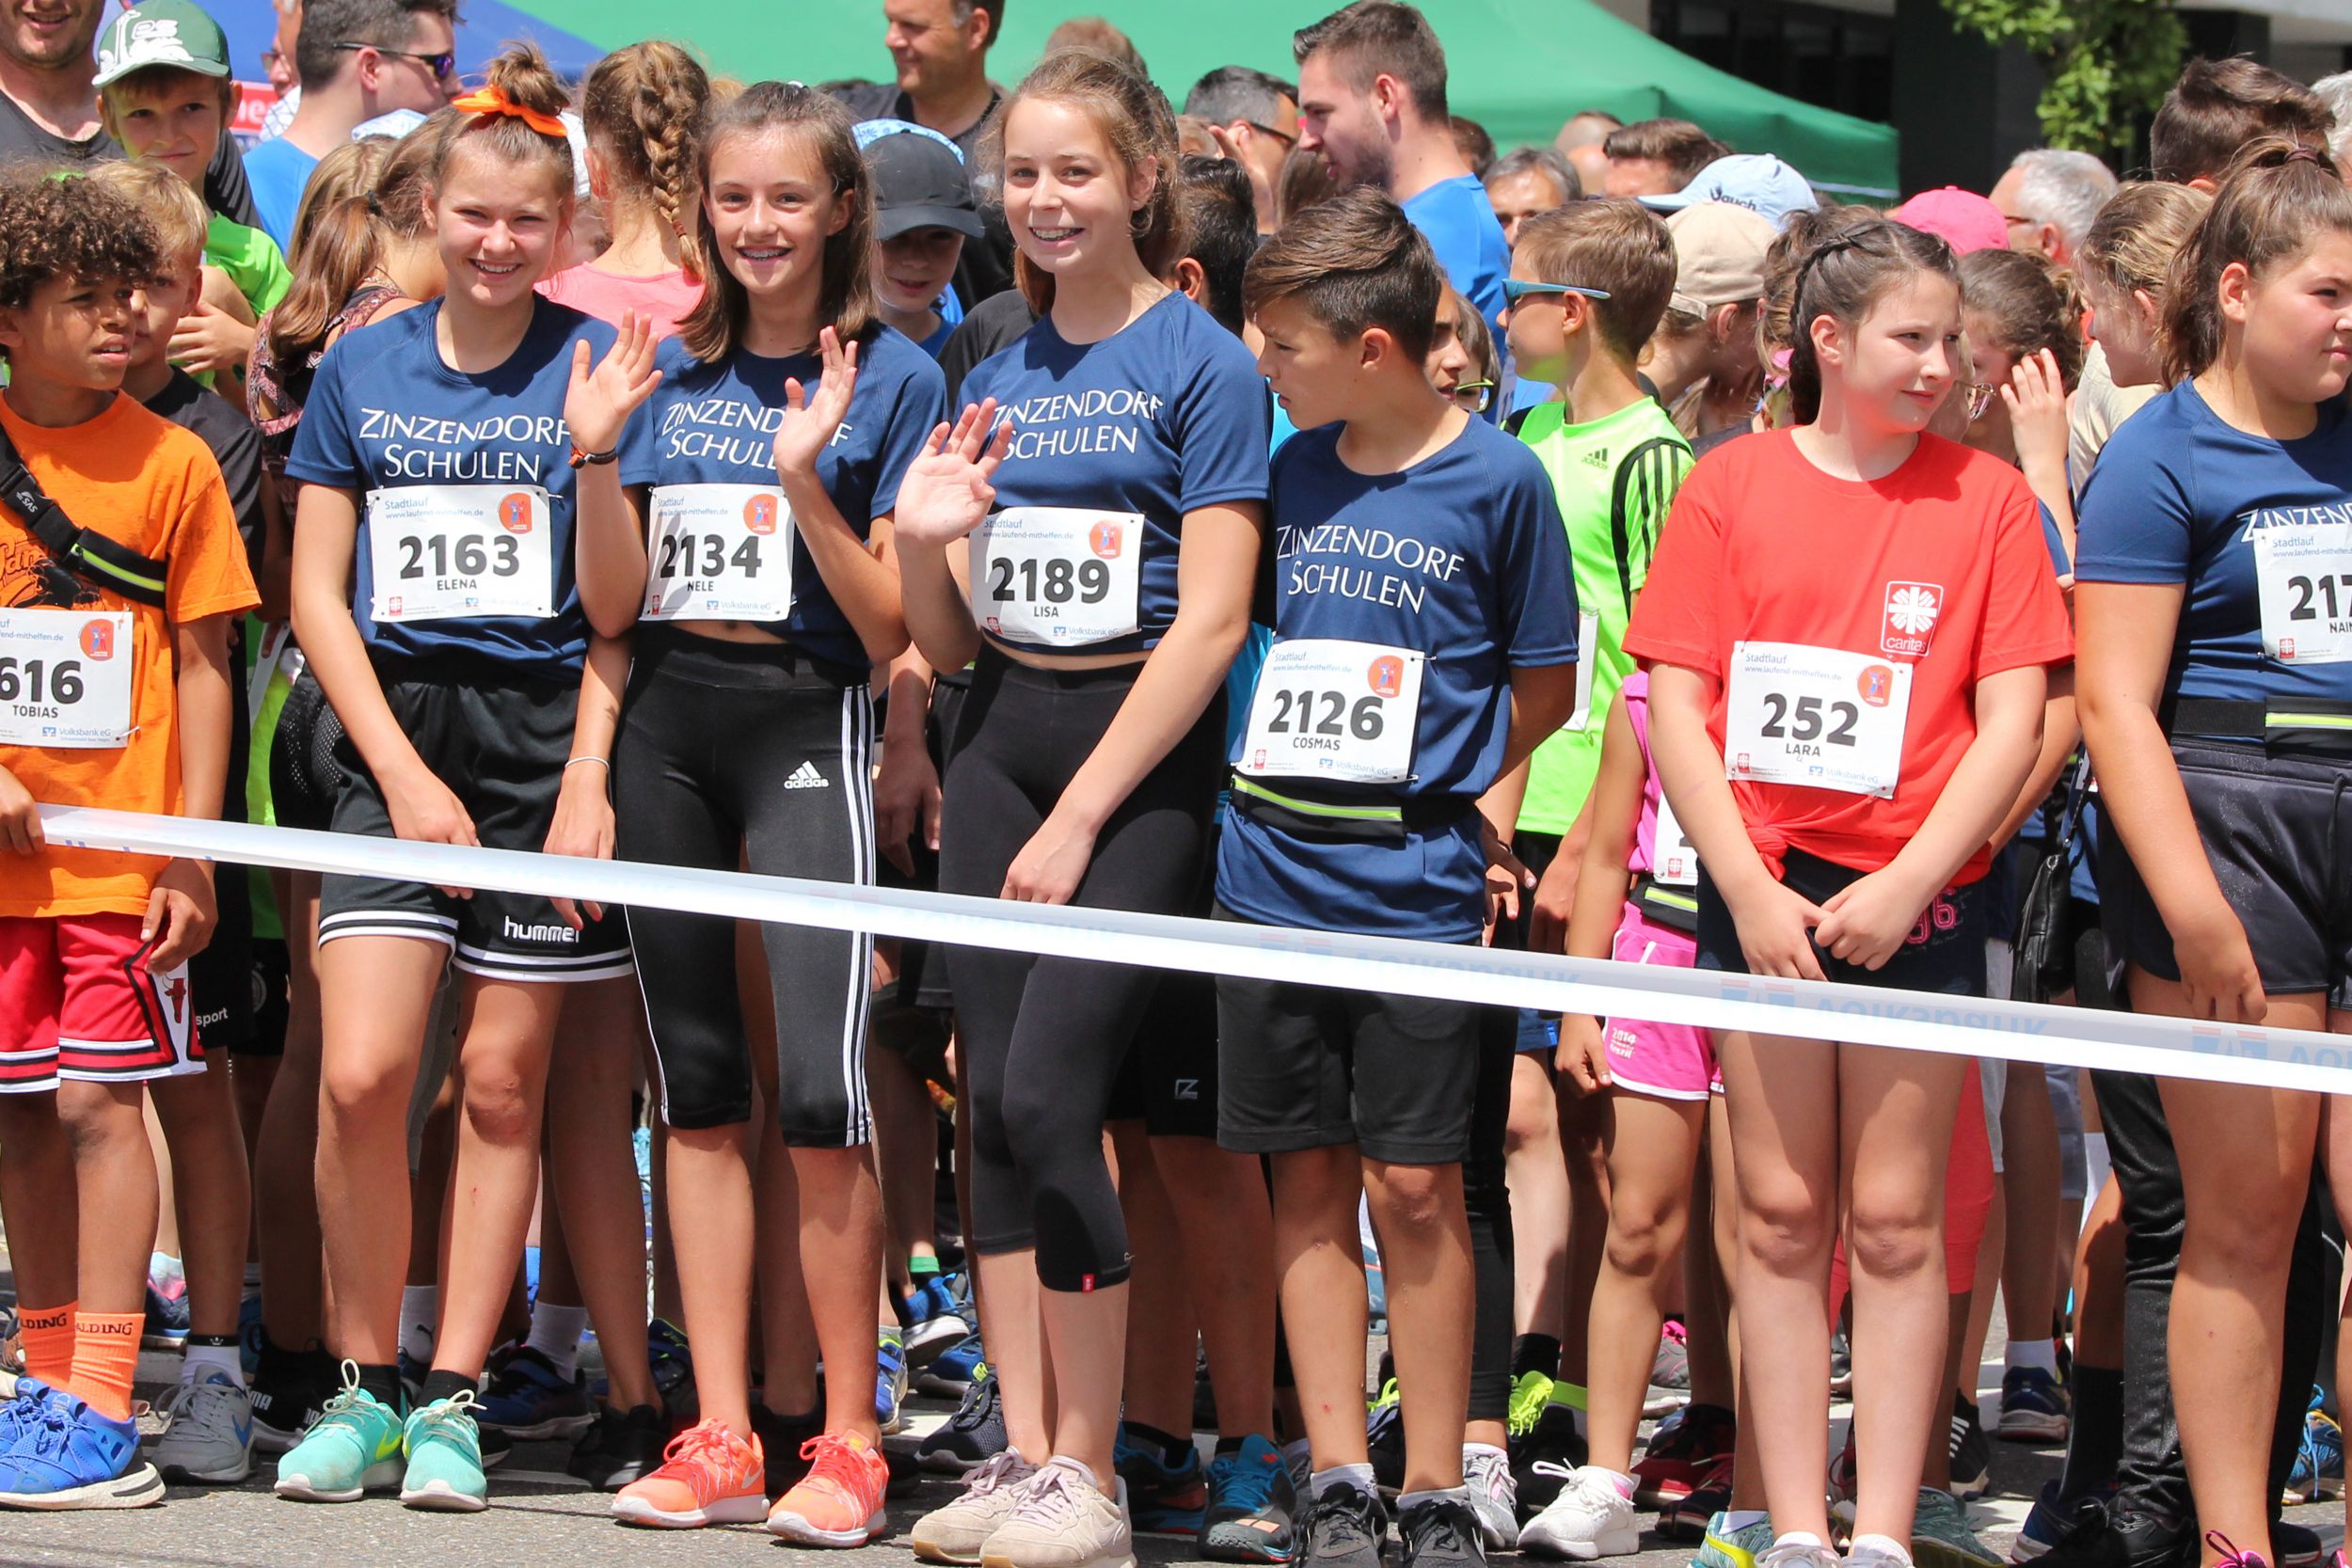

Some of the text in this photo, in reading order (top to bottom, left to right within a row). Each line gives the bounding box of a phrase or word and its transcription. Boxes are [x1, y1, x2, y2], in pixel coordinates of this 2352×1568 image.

[661, 399, 852, 448] ZINZENDF
[384, 444, 540, 482] SCHULEN
[385, 497, 428, 510] Stadtlauf
[984, 519, 1023, 529] Stadtlauf
[2273, 536, 2314, 547] Stadtlauf
[399, 533, 519, 579] 2163
[660, 533, 762, 578] 2134
[1276, 524, 1465, 581] ZINZENDORF
[437, 579, 477, 591] ELENA
[687, 580, 714, 592] NELE
[992, 557, 1110, 604] 2189
[1287, 561, 1425, 614] SCHULEN
[1033, 607, 1058, 617] LISA
[1746, 654, 1787, 664] Stadtlauf
[13, 705, 58, 719] TOBIAS
[1268, 689, 1383, 740] 2126
[1761, 692, 1859, 747] 252
[1293, 736, 1341, 751] COSMAS
[1786, 743, 1820, 757] LARA
[784, 778, 829, 789] adidas
[195, 1007, 228, 1027] sport
